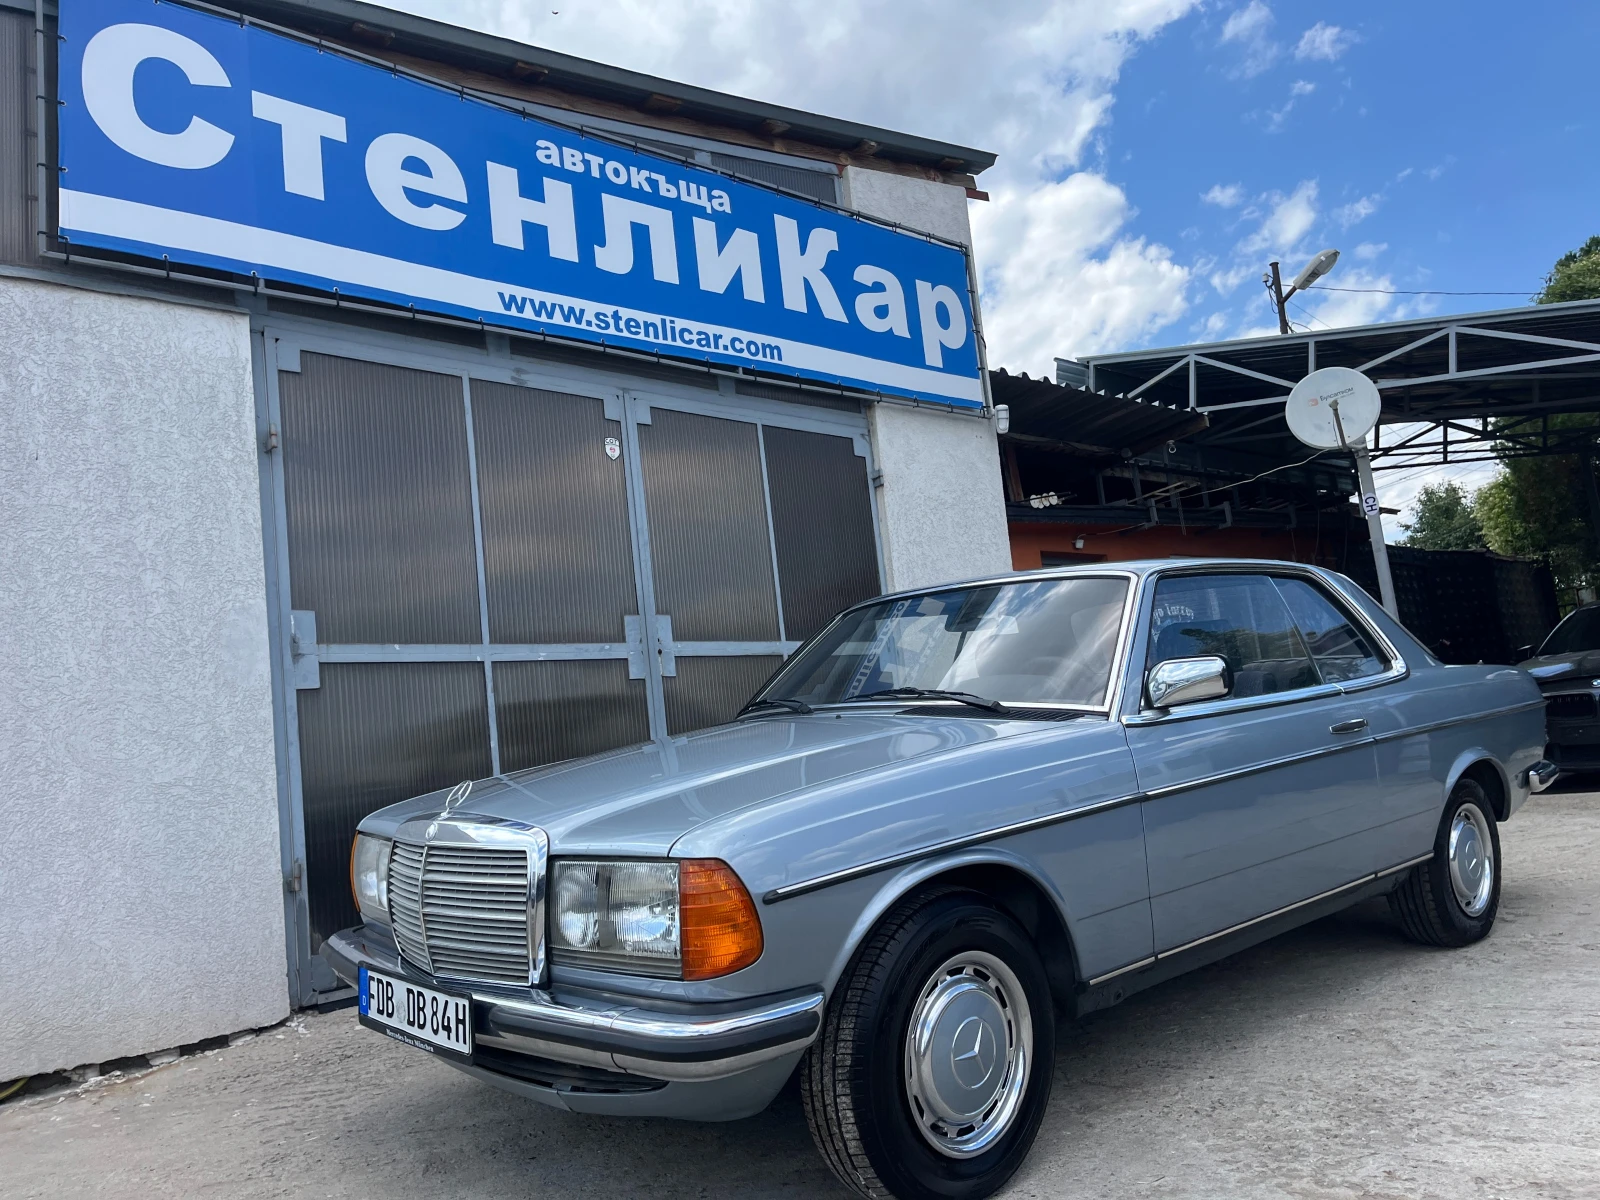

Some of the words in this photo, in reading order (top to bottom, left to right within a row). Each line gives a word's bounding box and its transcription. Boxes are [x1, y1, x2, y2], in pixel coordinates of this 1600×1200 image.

[82, 23, 967, 368] СтенлиКар
[536, 139, 732, 214] автокъща
[498, 291, 783, 361] www.stenlicar.com
[1365, 496, 1378, 513] CH
[368, 975, 395, 1019] FDB
[406, 987, 427, 1030] DB
[431, 995, 467, 1046] 84H
